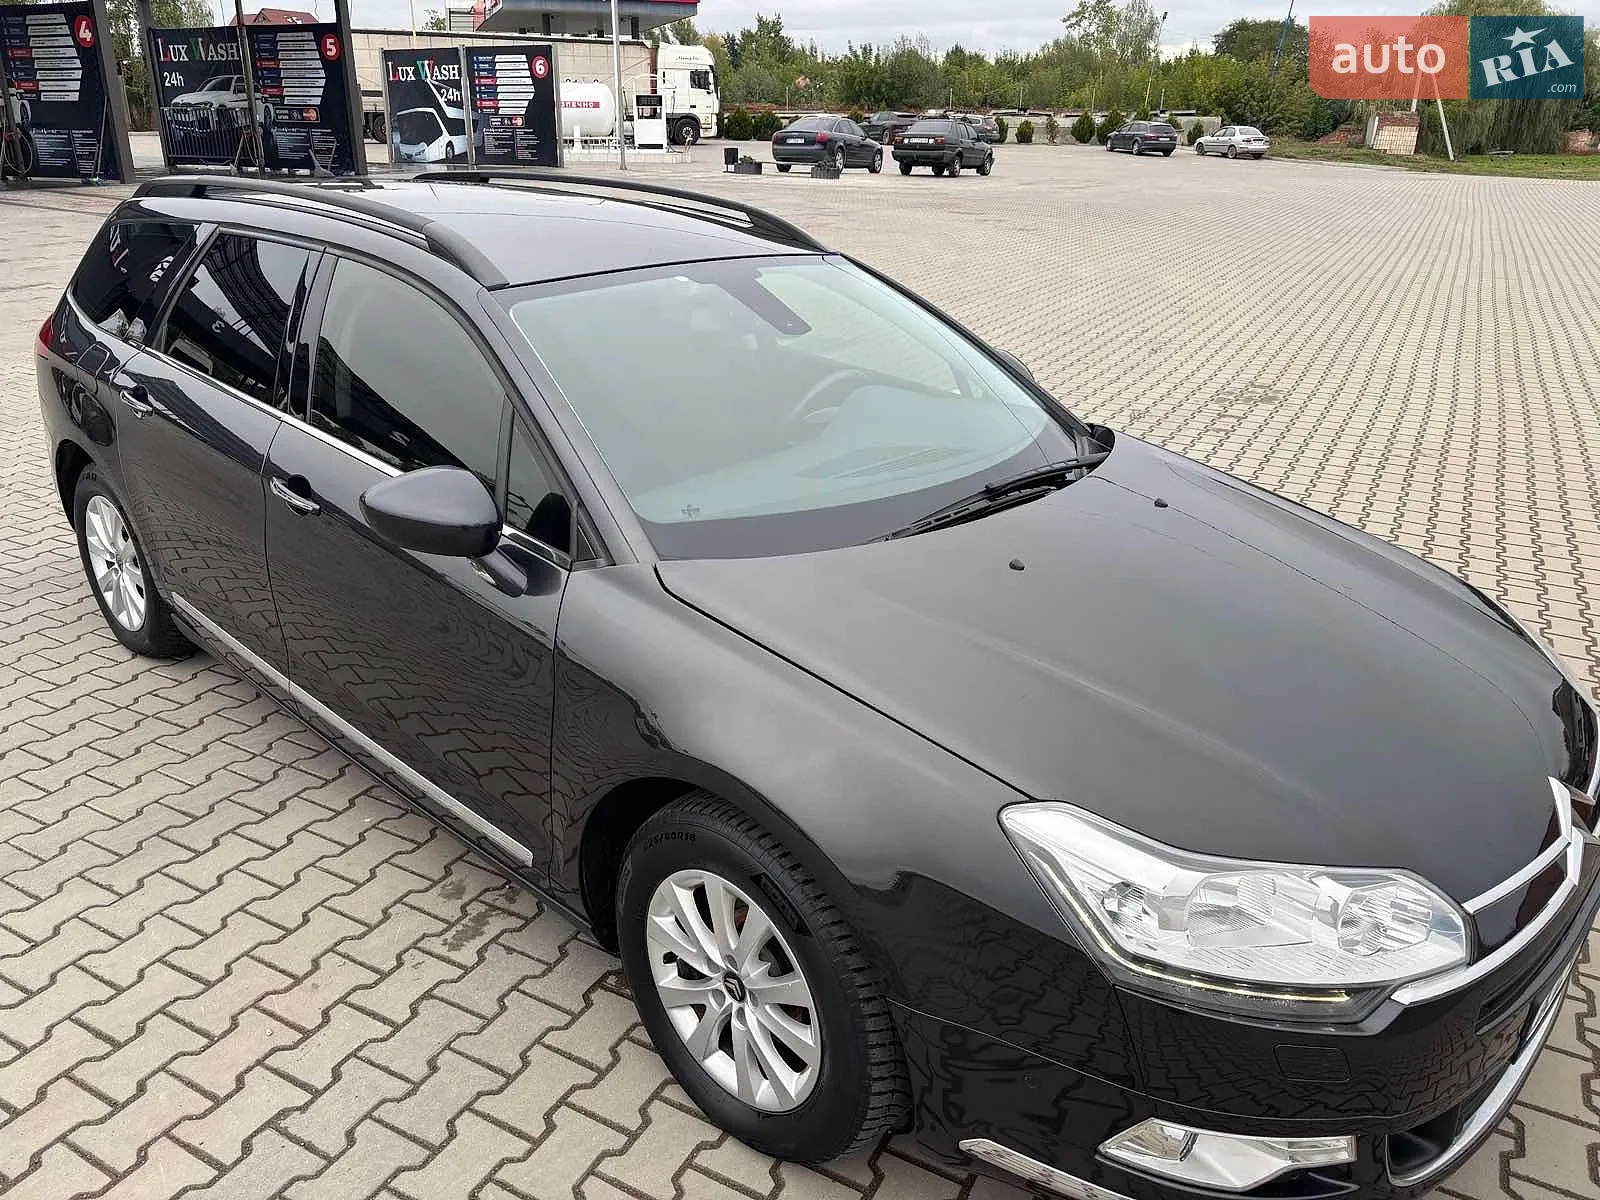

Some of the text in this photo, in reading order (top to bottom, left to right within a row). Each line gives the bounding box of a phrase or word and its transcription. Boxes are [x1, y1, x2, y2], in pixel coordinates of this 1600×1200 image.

[79, 20, 92, 42] 4
[157, 37, 240, 62] LUX WASH
[326, 38, 337, 56] 5
[387, 60, 460, 81] LUX WASH
[535, 60, 545, 75] 6
[163, 71, 185, 87] 24h
[440, 88, 461, 102] 24h
